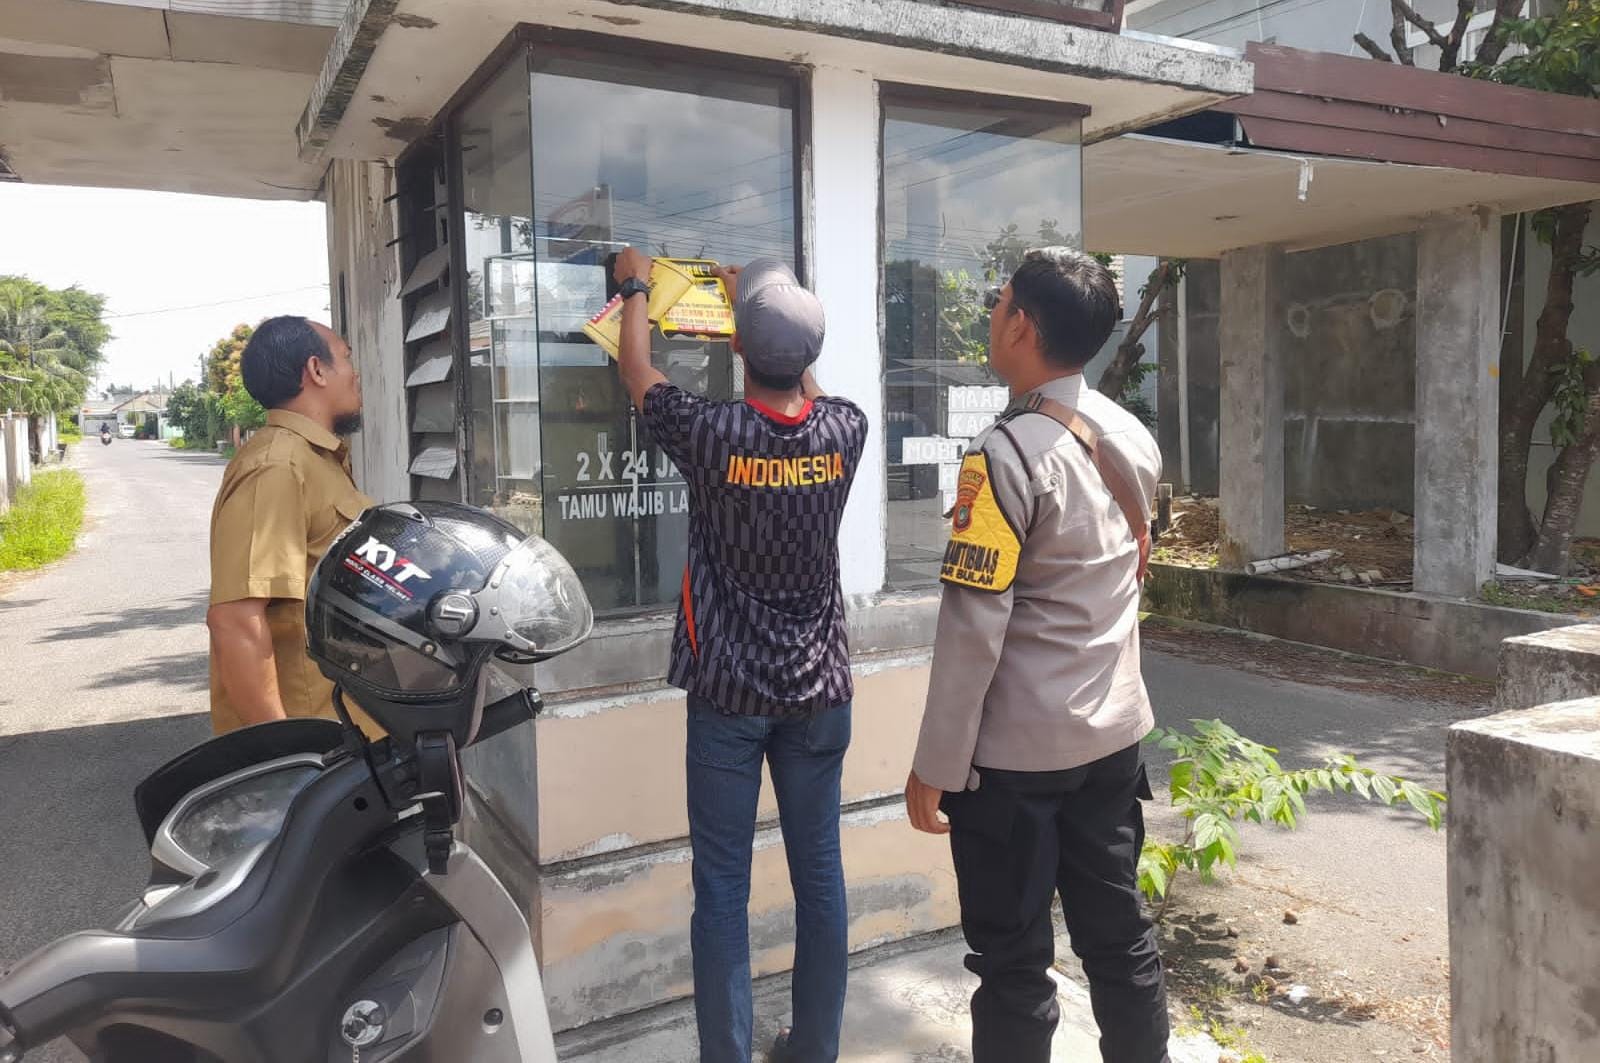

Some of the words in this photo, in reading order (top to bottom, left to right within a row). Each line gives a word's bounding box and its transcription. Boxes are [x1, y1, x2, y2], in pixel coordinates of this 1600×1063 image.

[576, 452, 591, 481] 2
[598, 451, 615, 480] X
[621, 450, 649, 480] 24
[727, 452, 844, 487] INDONESIA
[558, 493, 607, 520] TAMU
[611, 491, 665, 517] WAJIB
[354, 535, 433, 583] KYT
[956, 569, 995, 586] BULAN
